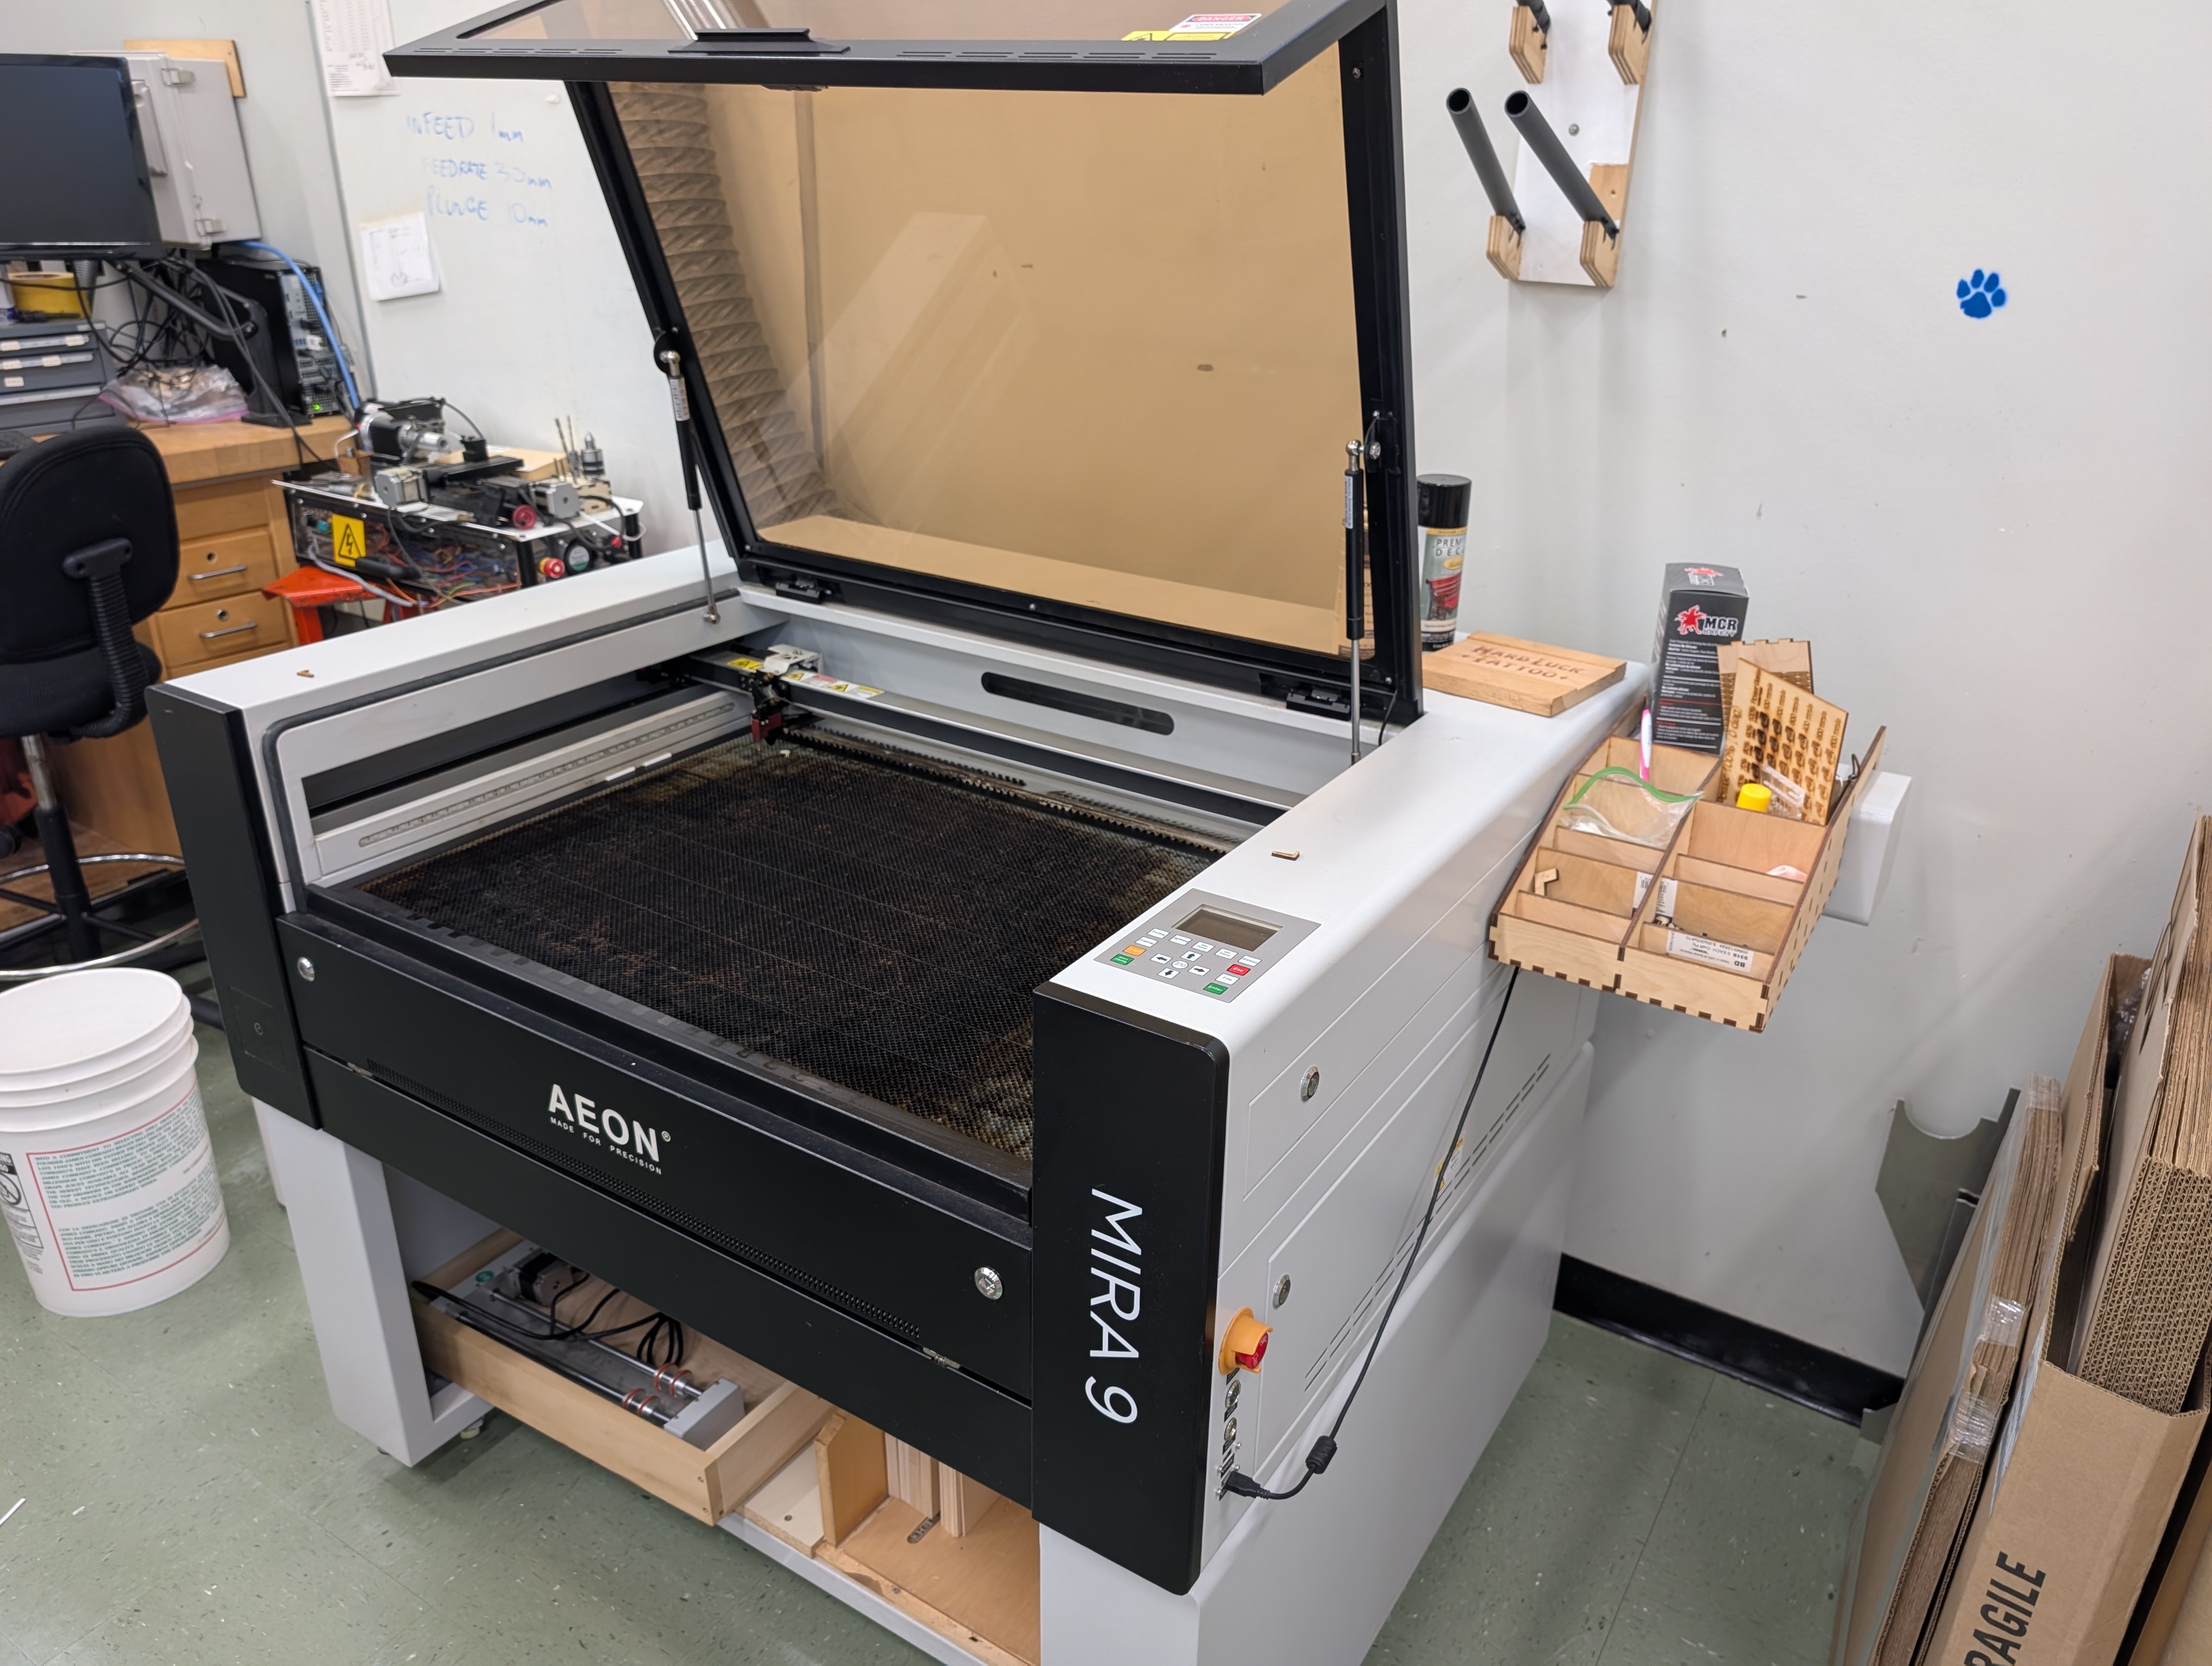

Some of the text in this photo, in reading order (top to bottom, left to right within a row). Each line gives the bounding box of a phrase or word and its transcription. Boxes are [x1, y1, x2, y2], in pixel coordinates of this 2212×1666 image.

[1704, 617, 1738, 630] MCR
[1471, 645, 1586, 674] HARD LUCK
[1473, 655, 1558, 678] TATTOO
[550, 1116, 663, 1175] MADE FOR PRECISION
[1085, 1188, 1143, 1424] MIRA 9
